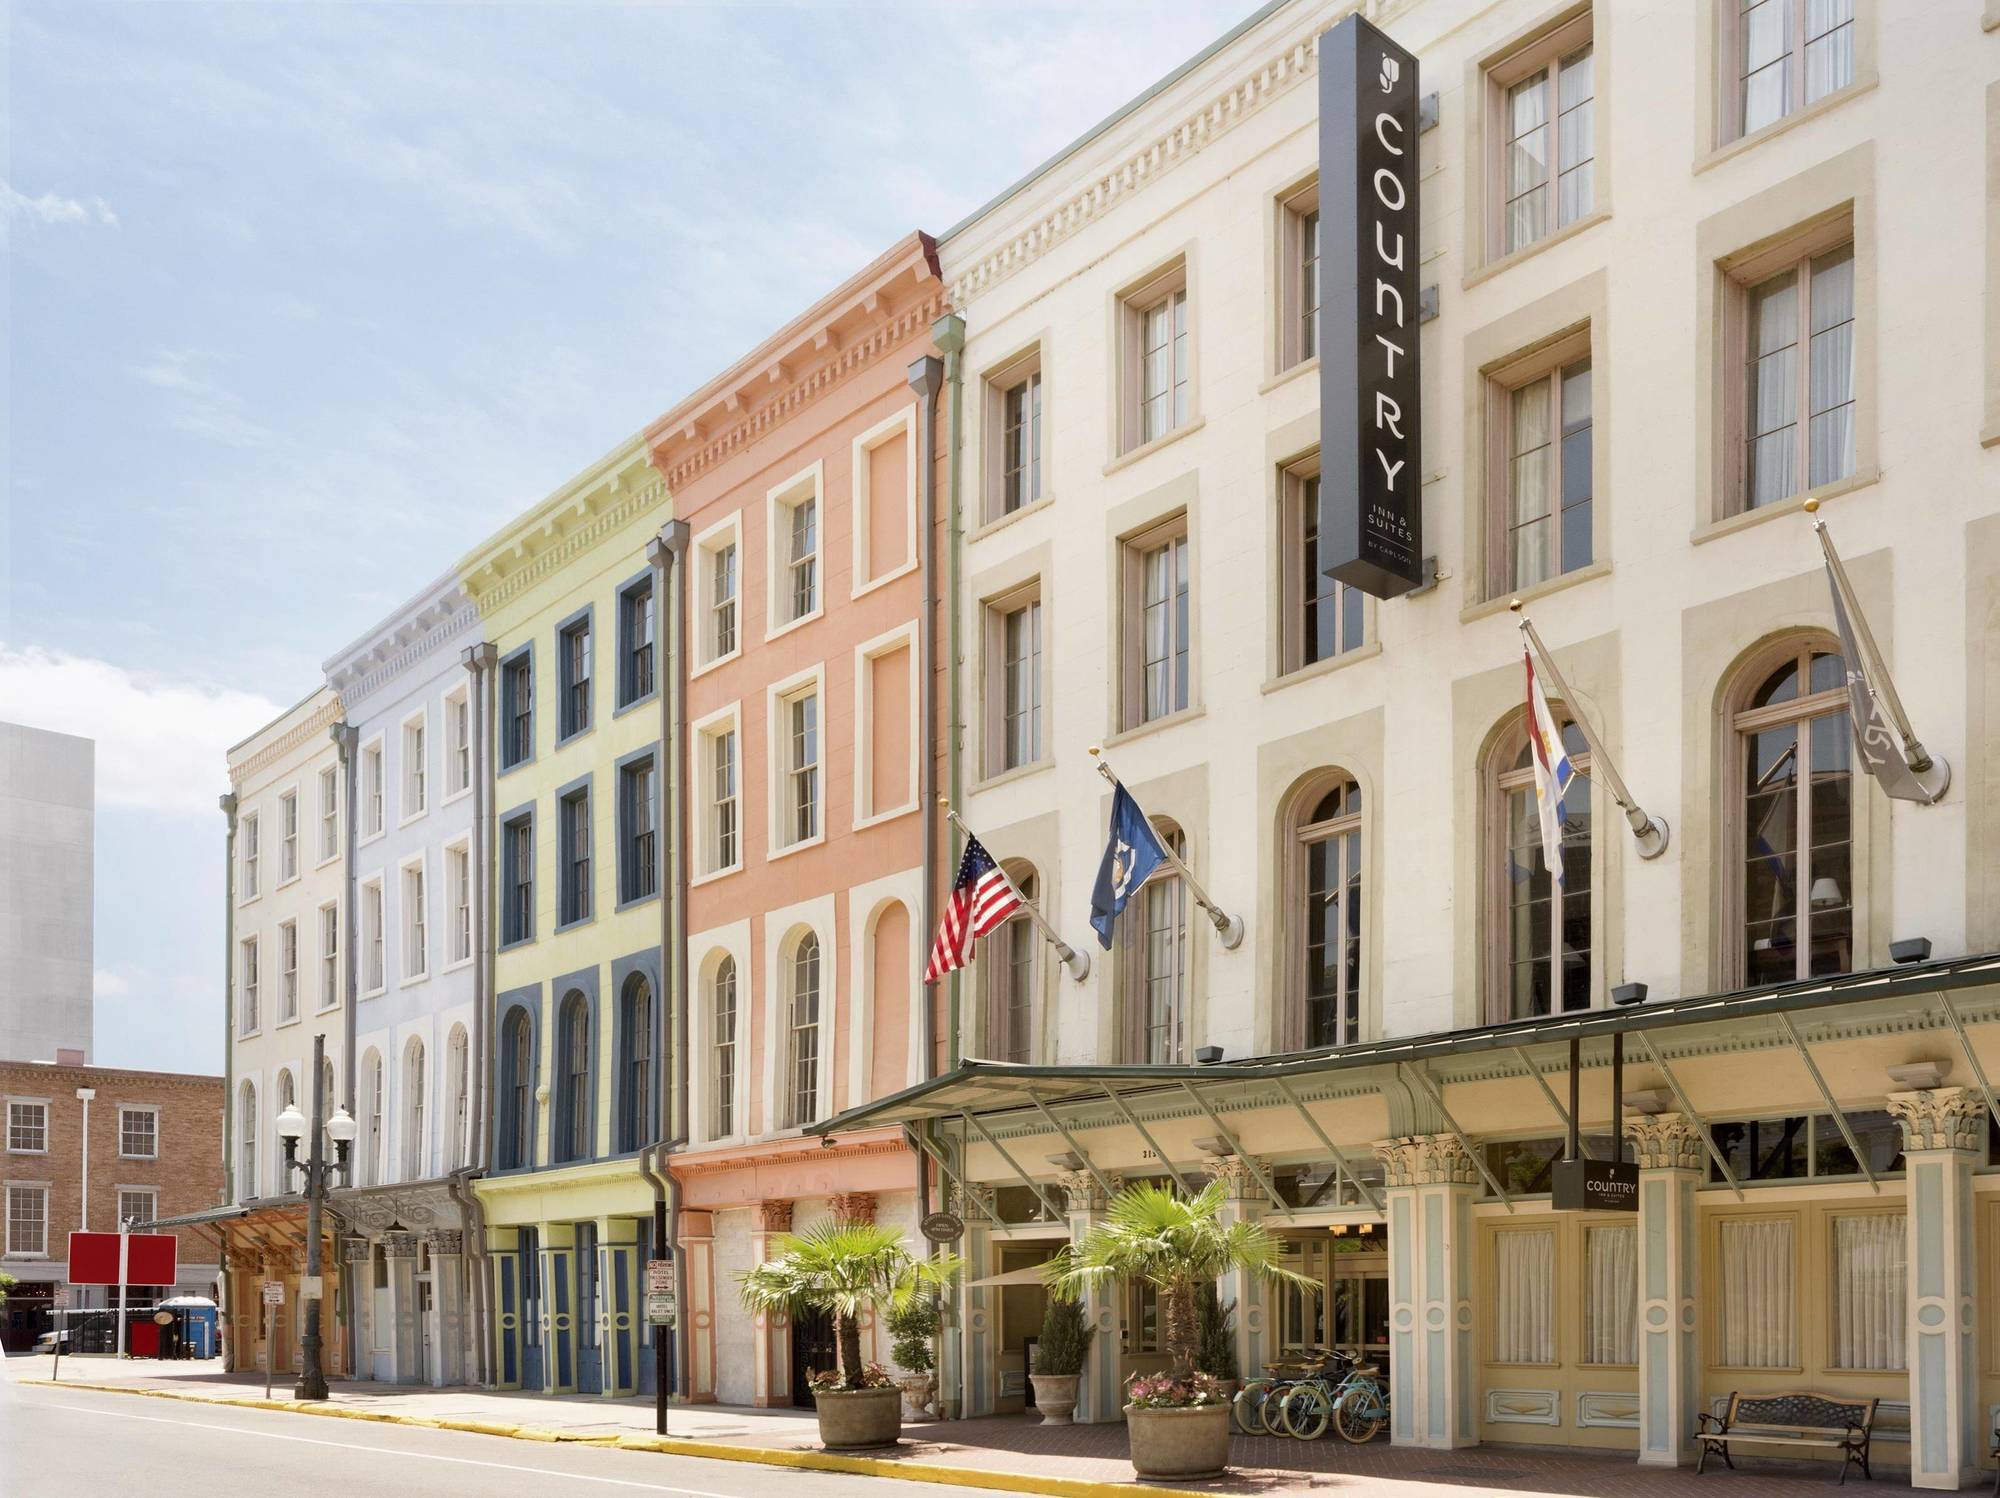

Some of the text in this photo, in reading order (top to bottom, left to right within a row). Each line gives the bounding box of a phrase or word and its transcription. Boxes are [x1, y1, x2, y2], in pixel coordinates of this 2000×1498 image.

[1368, 513, 1412, 541] SUITES
[1373, 503, 1407, 527] INN &
